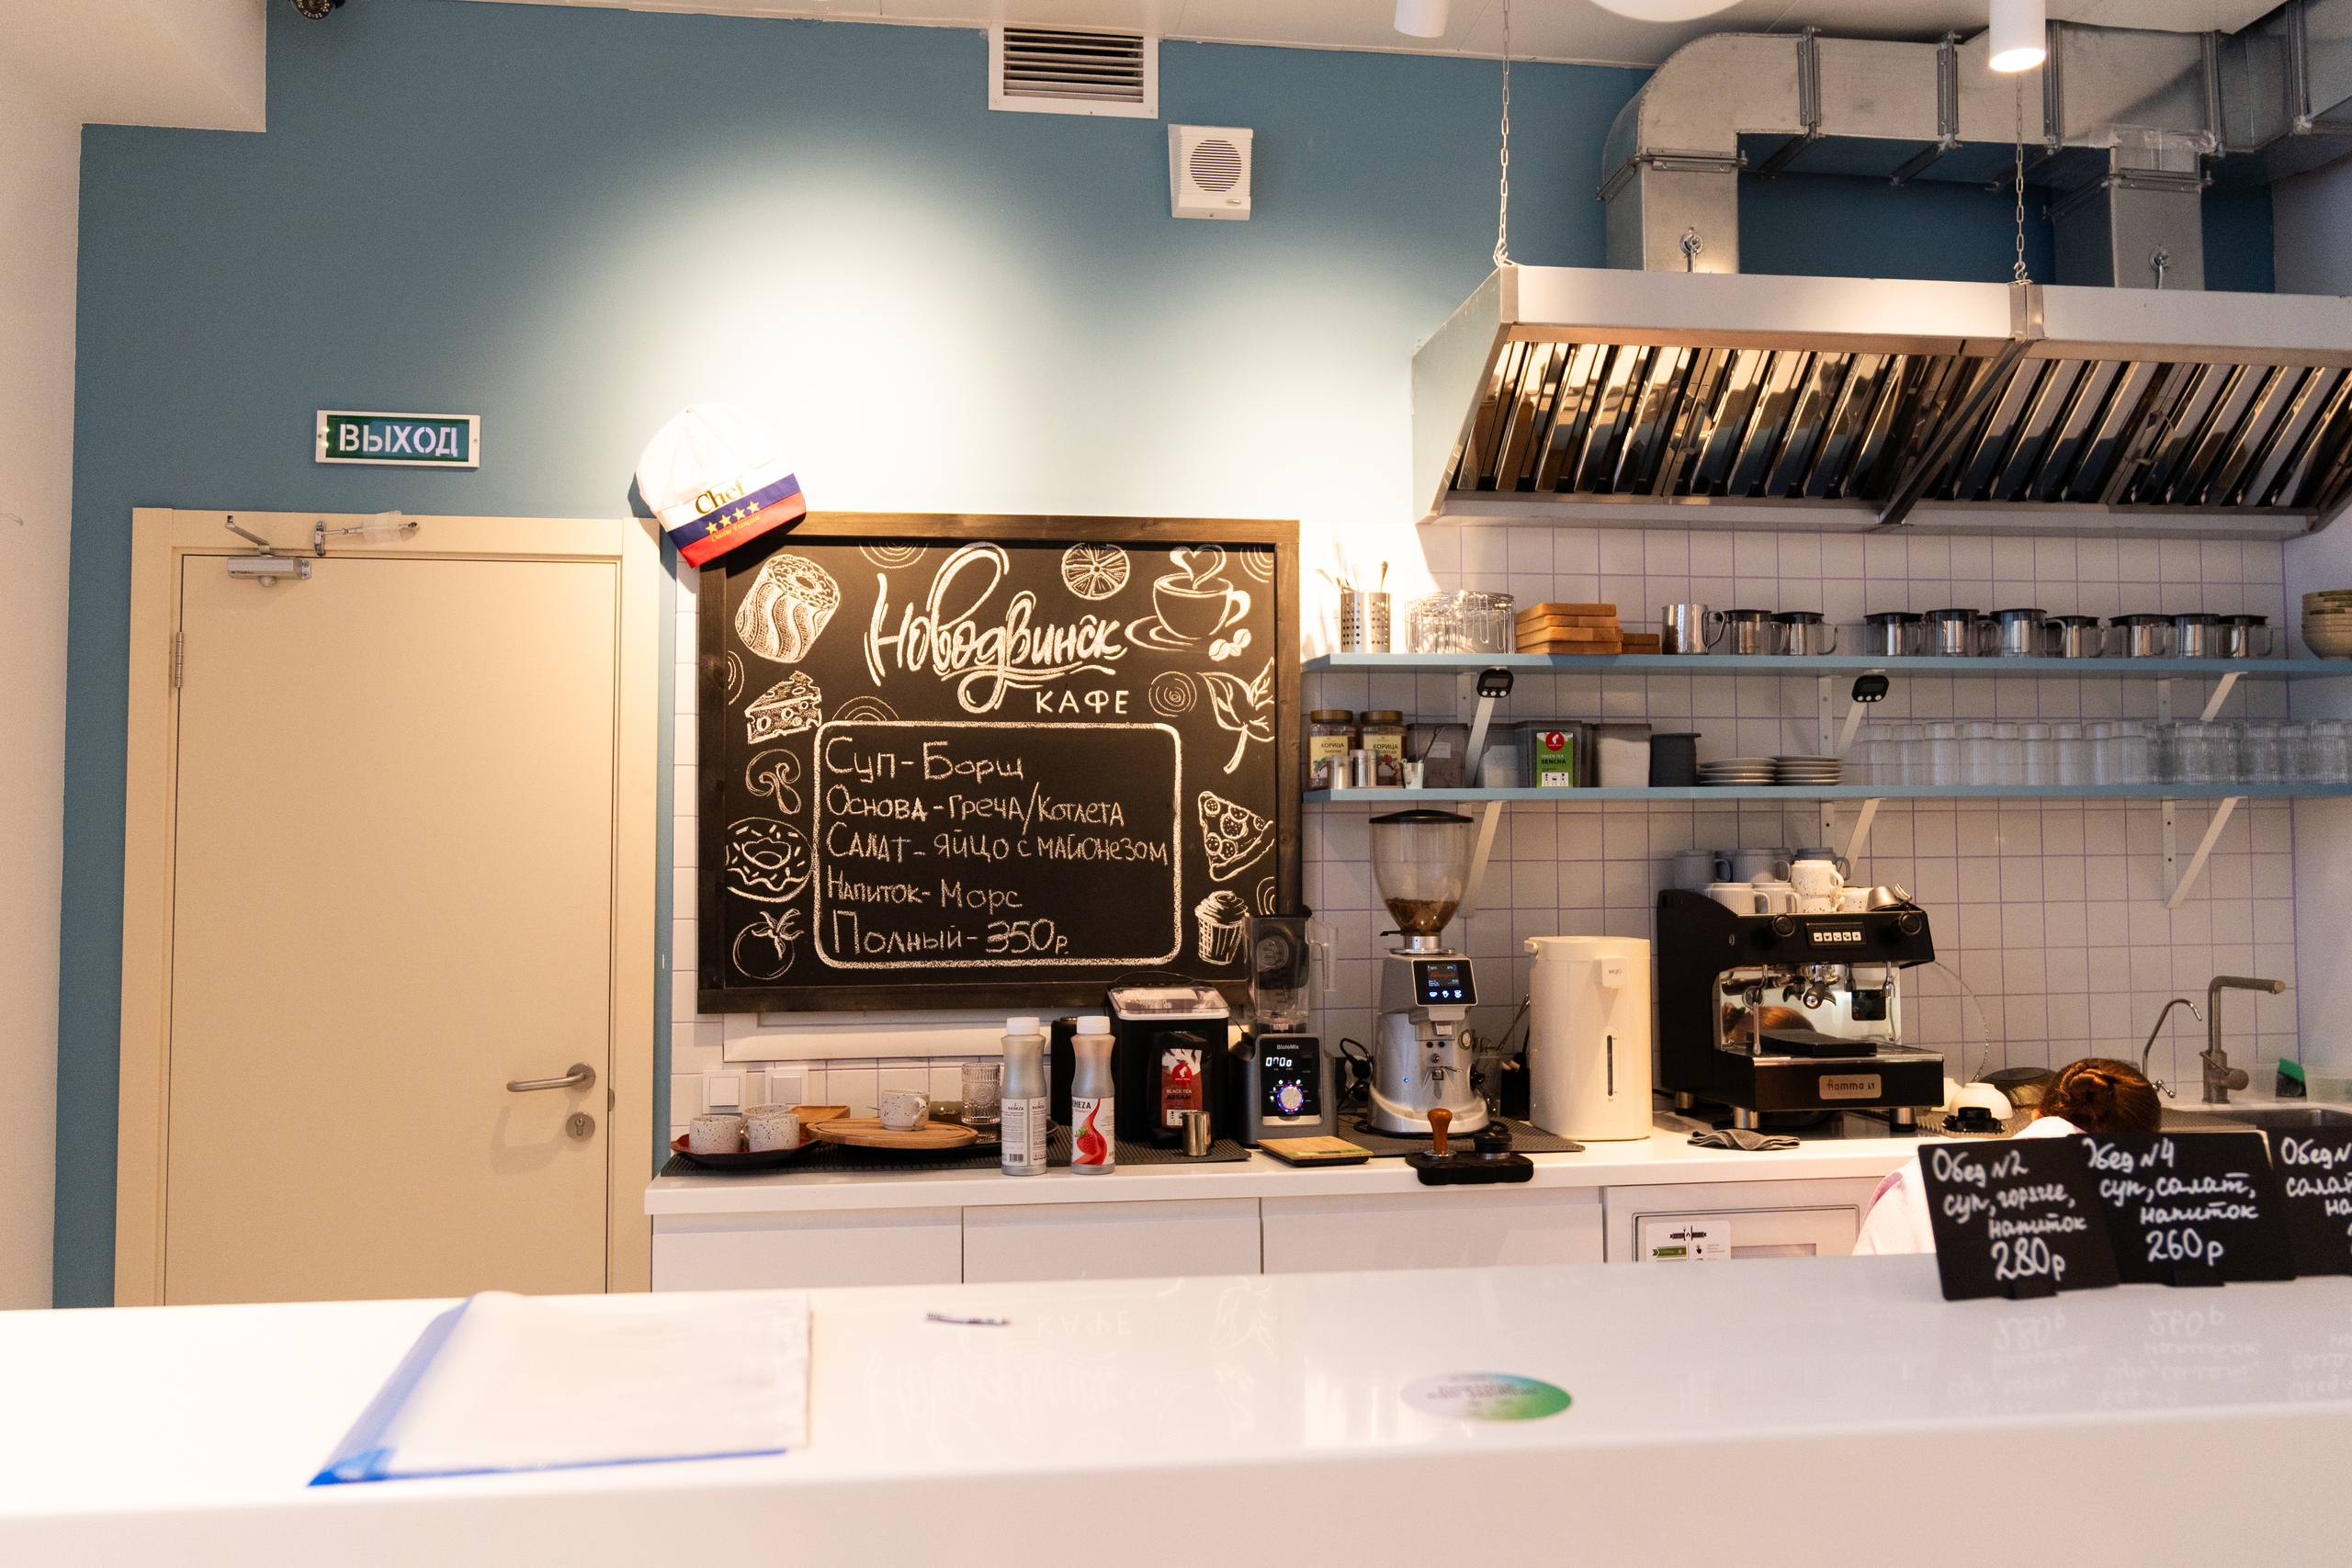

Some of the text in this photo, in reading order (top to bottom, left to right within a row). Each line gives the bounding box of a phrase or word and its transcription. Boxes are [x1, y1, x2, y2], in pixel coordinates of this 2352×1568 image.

[339, 423, 458, 457] ВЫХОД
[695, 476, 746, 514] Chef
[711, 528, 733, 543] Cuisine
[864, 541, 1128, 715] Новодвинск
[1035, 689, 1130, 715] КАФЕ
[922, 740, 1023, 784] Борщ
[933, 829, 1010, 863] яйцо
[1017, 835, 1032, 858] с
[941, 878, 1023, 916] Морс
[1826, 1078, 1864, 1091] fiamma
[1932, 1147, 1987, 1189] Обед
[2280, 1136, 2333, 1170] Обед
[1987, 1213, 2087, 1240] напиток
[2139, 1201, 2260, 1225] напиток
